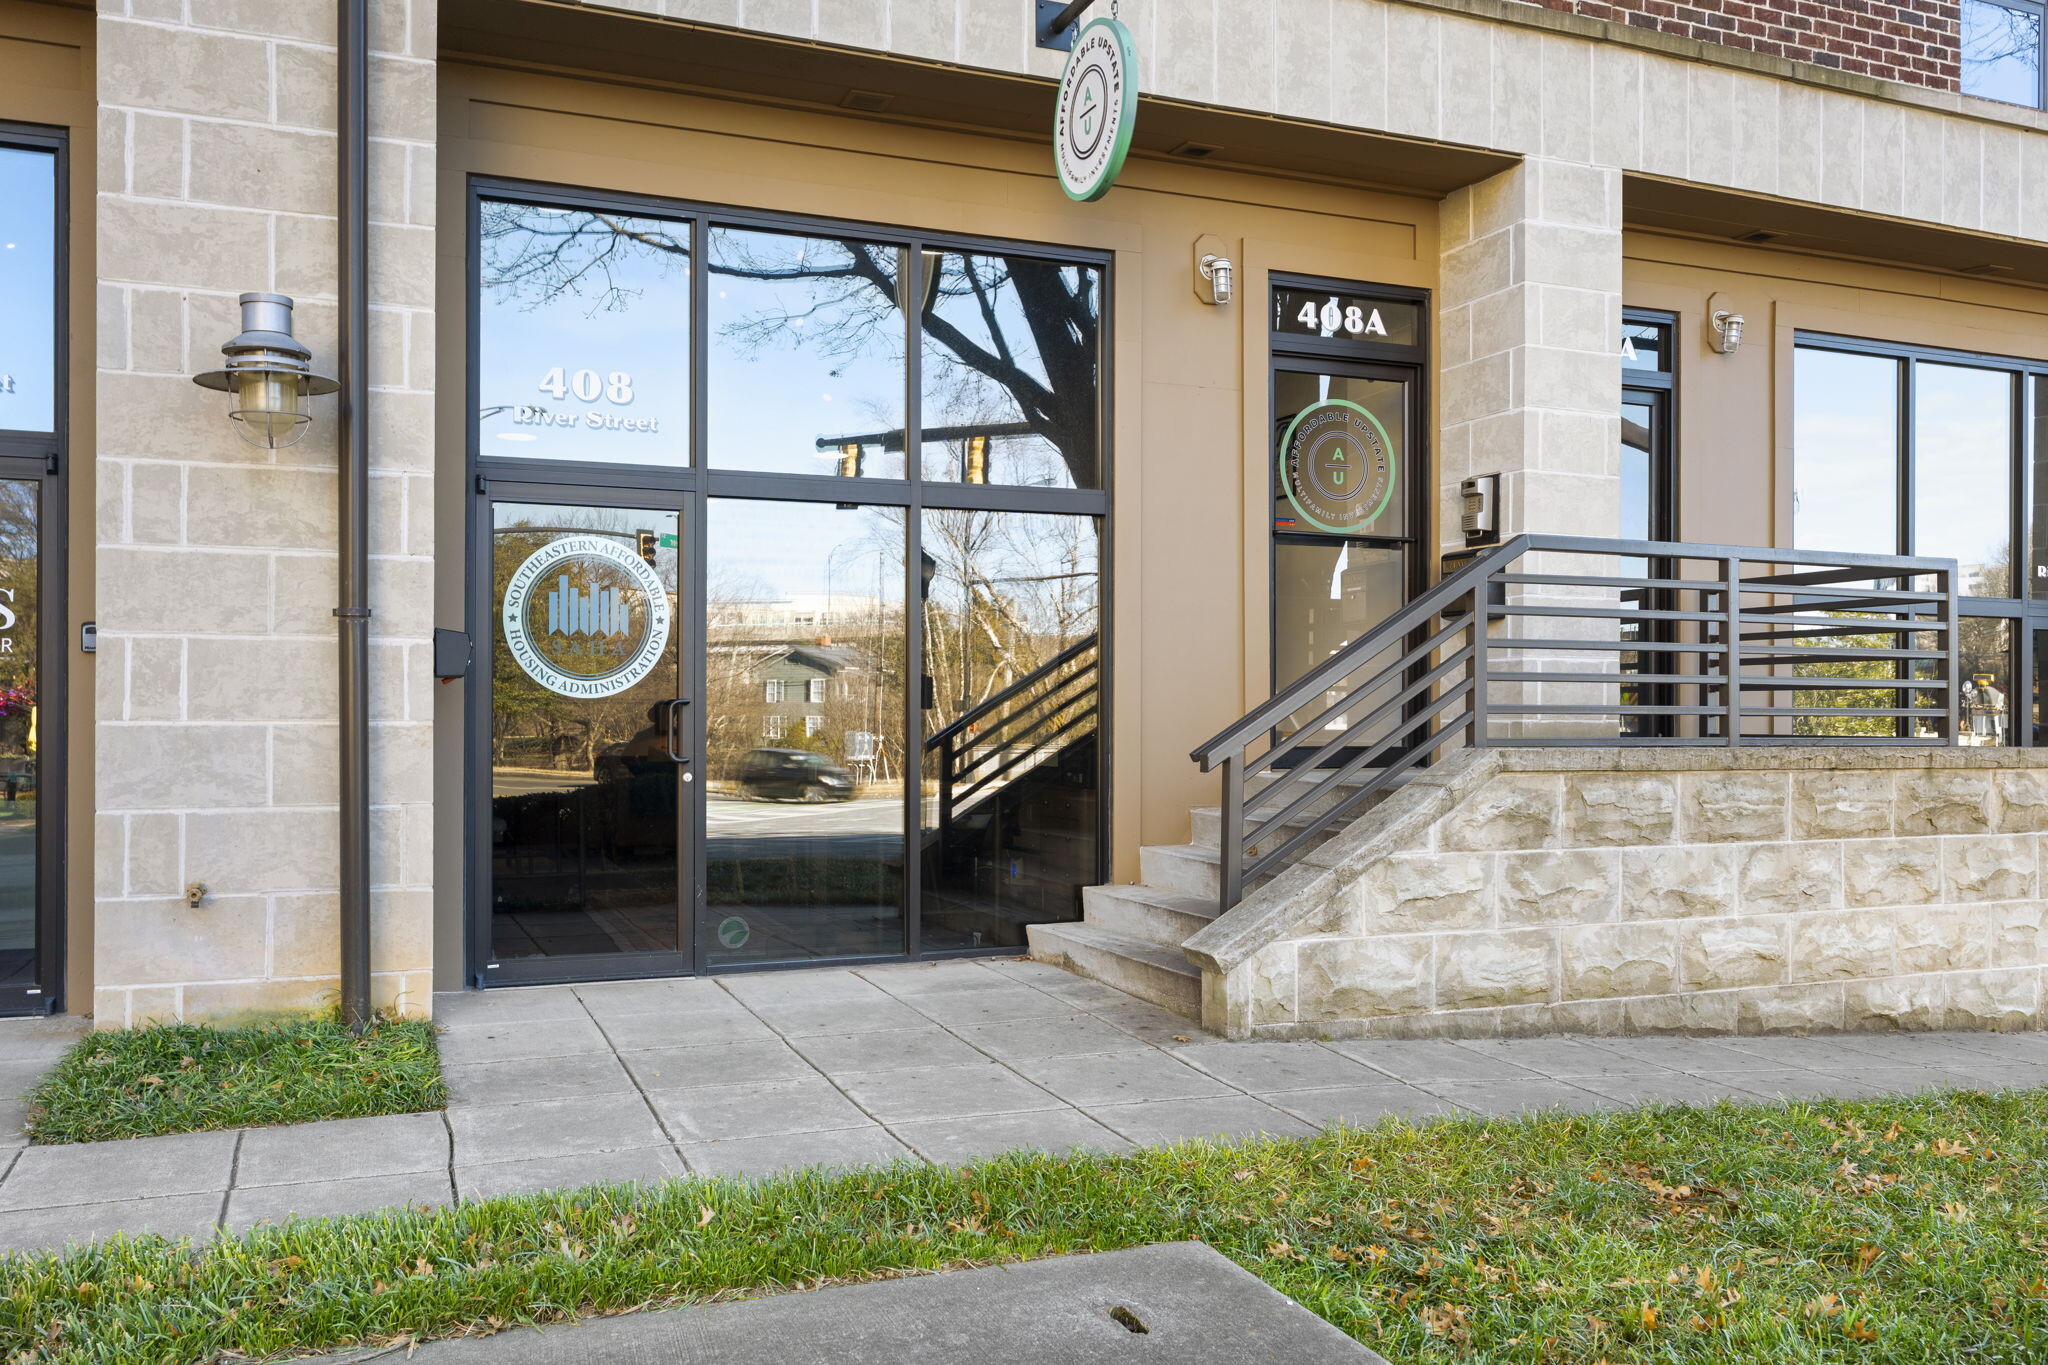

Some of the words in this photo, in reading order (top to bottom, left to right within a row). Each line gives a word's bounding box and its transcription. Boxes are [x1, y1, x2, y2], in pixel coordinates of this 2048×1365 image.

[1059, 37, 1095, 137] AFFORDABLE
[1098, 36, 1120, 93] UPSTATE
[1084, 86, 1092, 106] A
[1084, 117, 1092, 136] U
[1297, 301, 1388, 337] 408A
[538, 367, 635, 406] 408
[512, 405, 579, 427] River
[585, 410, 660, 433] Street
[1291, 411, 1350, 467] AFFORDABLE
[1354, 418, 1385, 472] UPSTATE
[1332, 447, 1345, 461] A
[1333, 471, 1344, 485] U
[508, 540, 599, 608] SOUTHEASTERN
[600, 543, 666, 612] AFFORDABLE
[509, 629, 557, 687] HOUSING
[558, 629, 664, 694] ADMINISTRATION
[551, 639, 628, 657] SAHA
